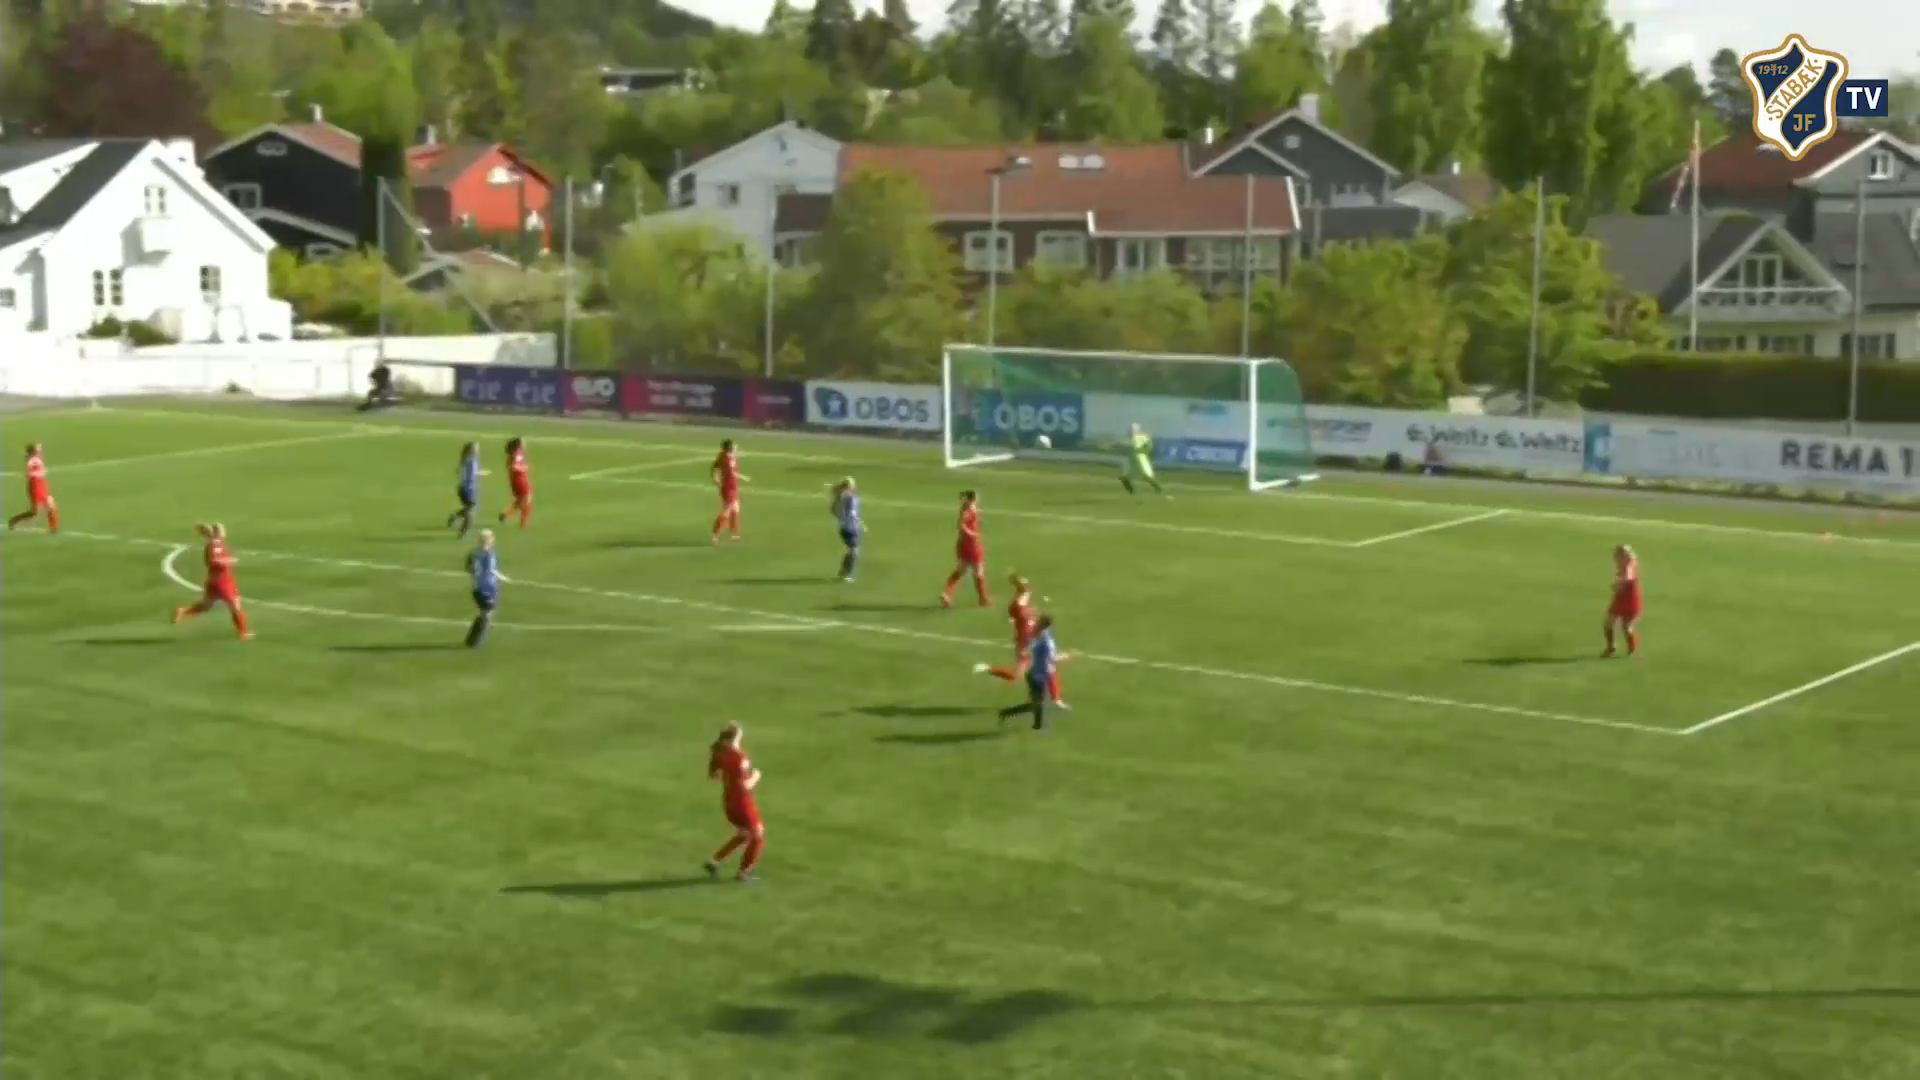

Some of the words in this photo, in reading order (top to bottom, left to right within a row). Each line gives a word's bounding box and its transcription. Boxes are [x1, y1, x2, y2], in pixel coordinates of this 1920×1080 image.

[855, 397, 930, 423] OBOS
[992, 402, 1079, 434] OBOS
[1781, 439, 1890, 475] REMA
